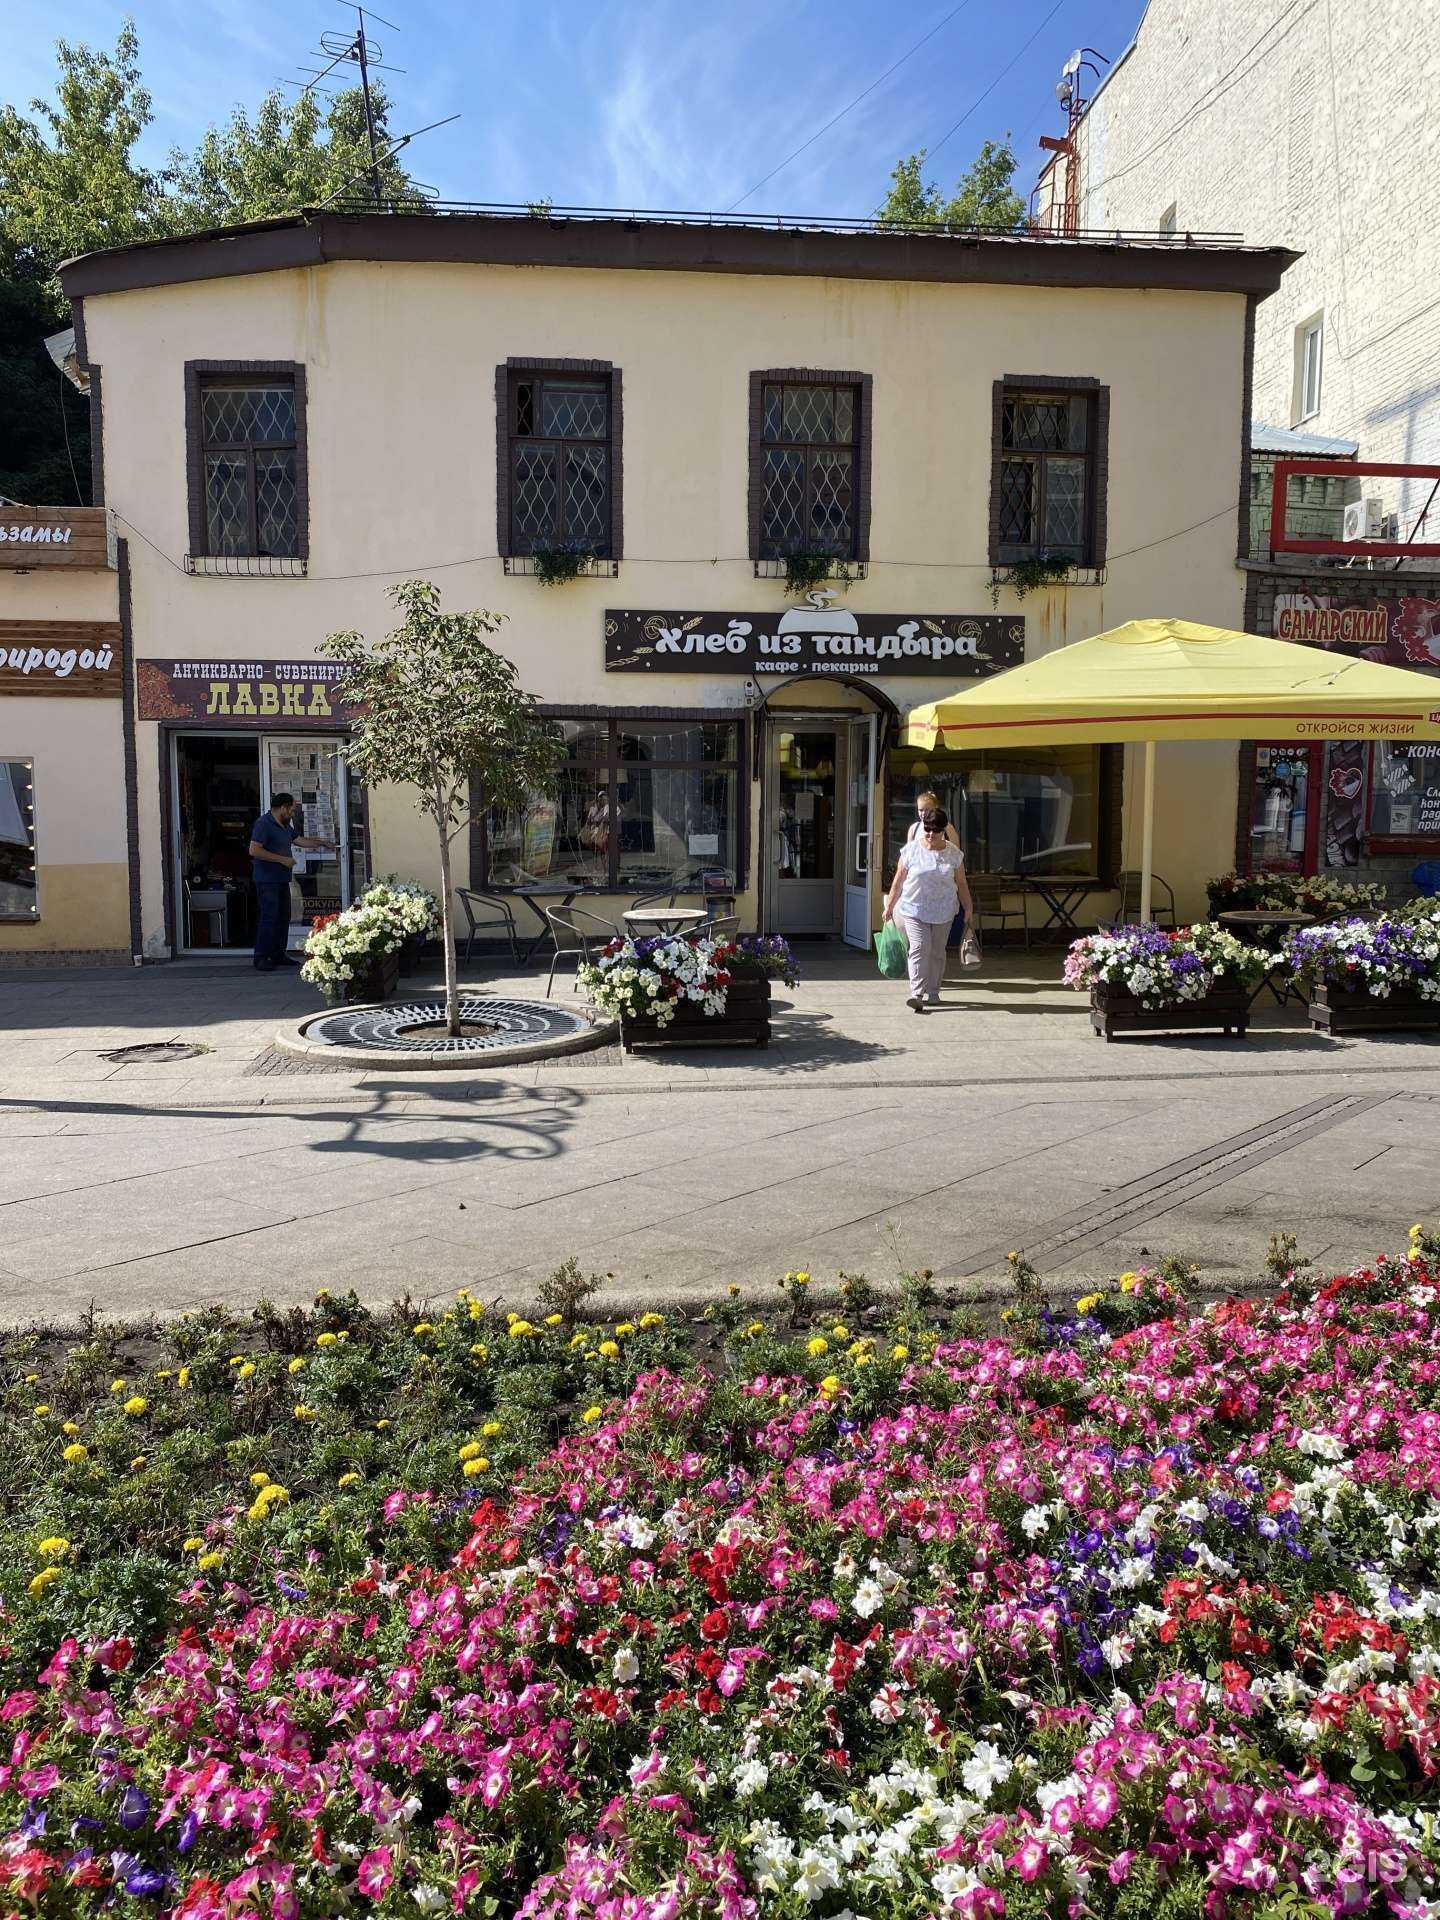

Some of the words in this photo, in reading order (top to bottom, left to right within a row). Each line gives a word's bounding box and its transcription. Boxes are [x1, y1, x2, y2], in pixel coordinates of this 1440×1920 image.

[1279, 605, 1388, 643] САМАРСКИЙ
[655, 619, 753, 654] Хлеб
[758, 634, 802, 654] из
[811, 621, 978, 660] тандыра
[275, 664, 361, 681] СУВЕНИРНА
[755, 661, 799, 673] кафе
[811, 662, 879, 674] пекарня
[206, 682, 332, 716] ЛАВКА
[1296, 721, 1364, 734] ОТКРОЙСЯ
[1369, 723, 1415, 734] ЖИЗНИ
[1420, 798, 1440, 809] кон
